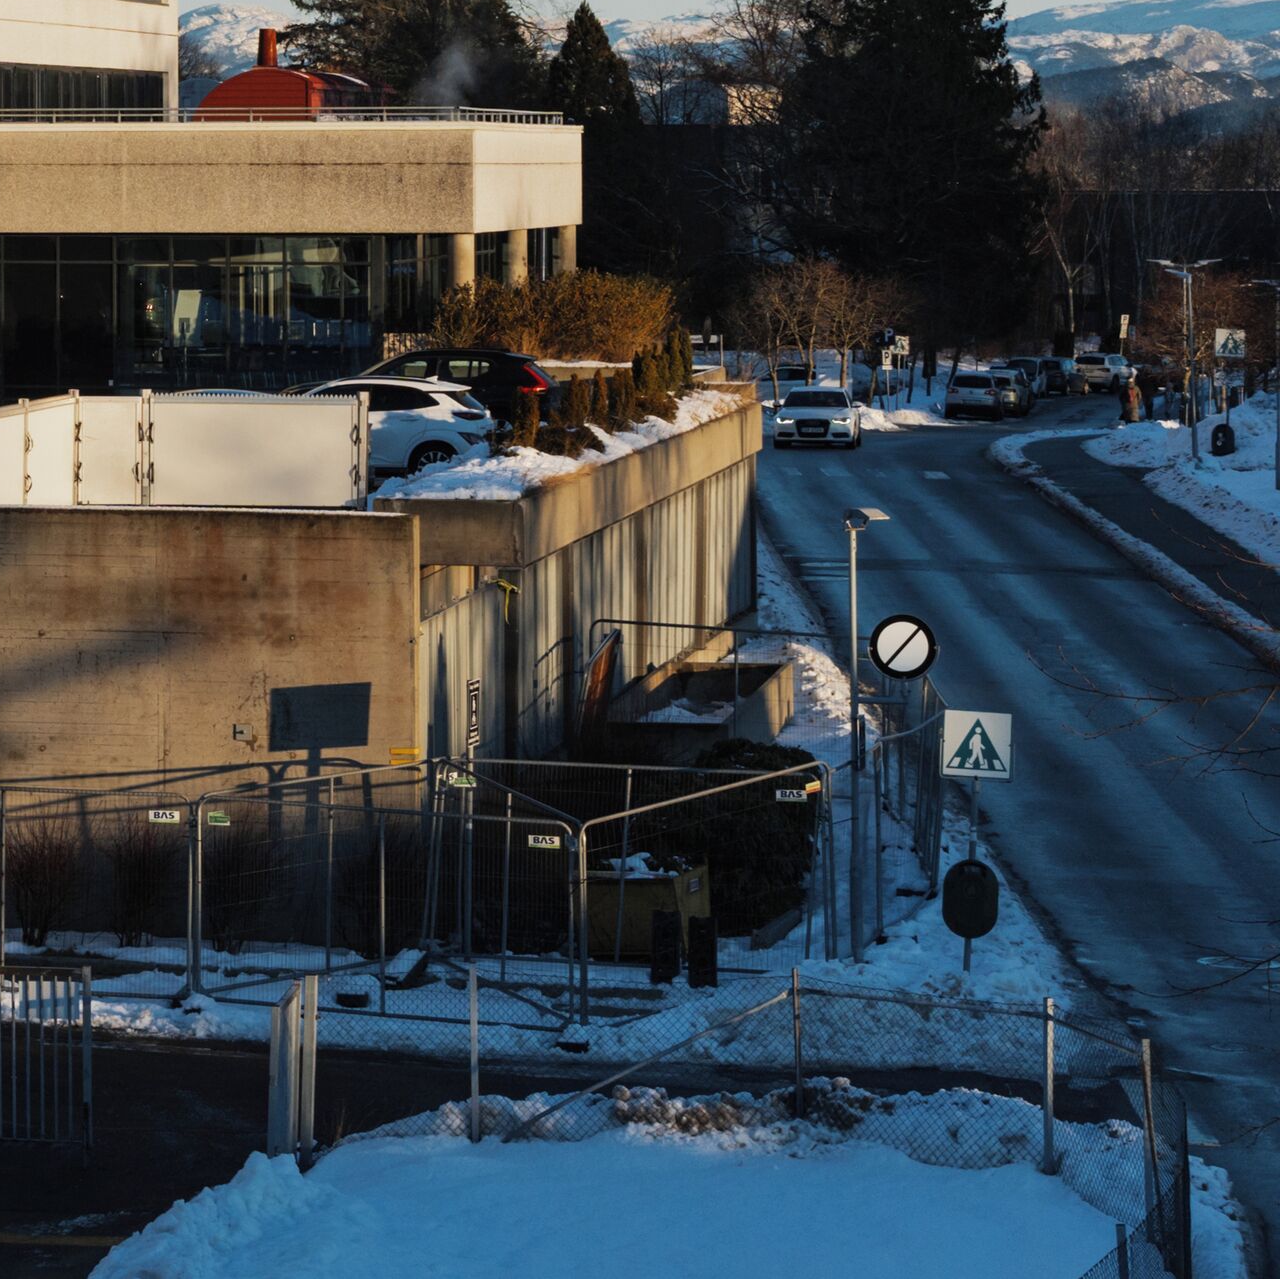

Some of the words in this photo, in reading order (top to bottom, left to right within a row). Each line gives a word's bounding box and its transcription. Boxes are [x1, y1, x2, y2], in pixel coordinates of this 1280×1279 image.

[780, 790, 802, 798] BAS
[153, 811, 175, 819] BAS
[533, 836, 555, 845] BAS
